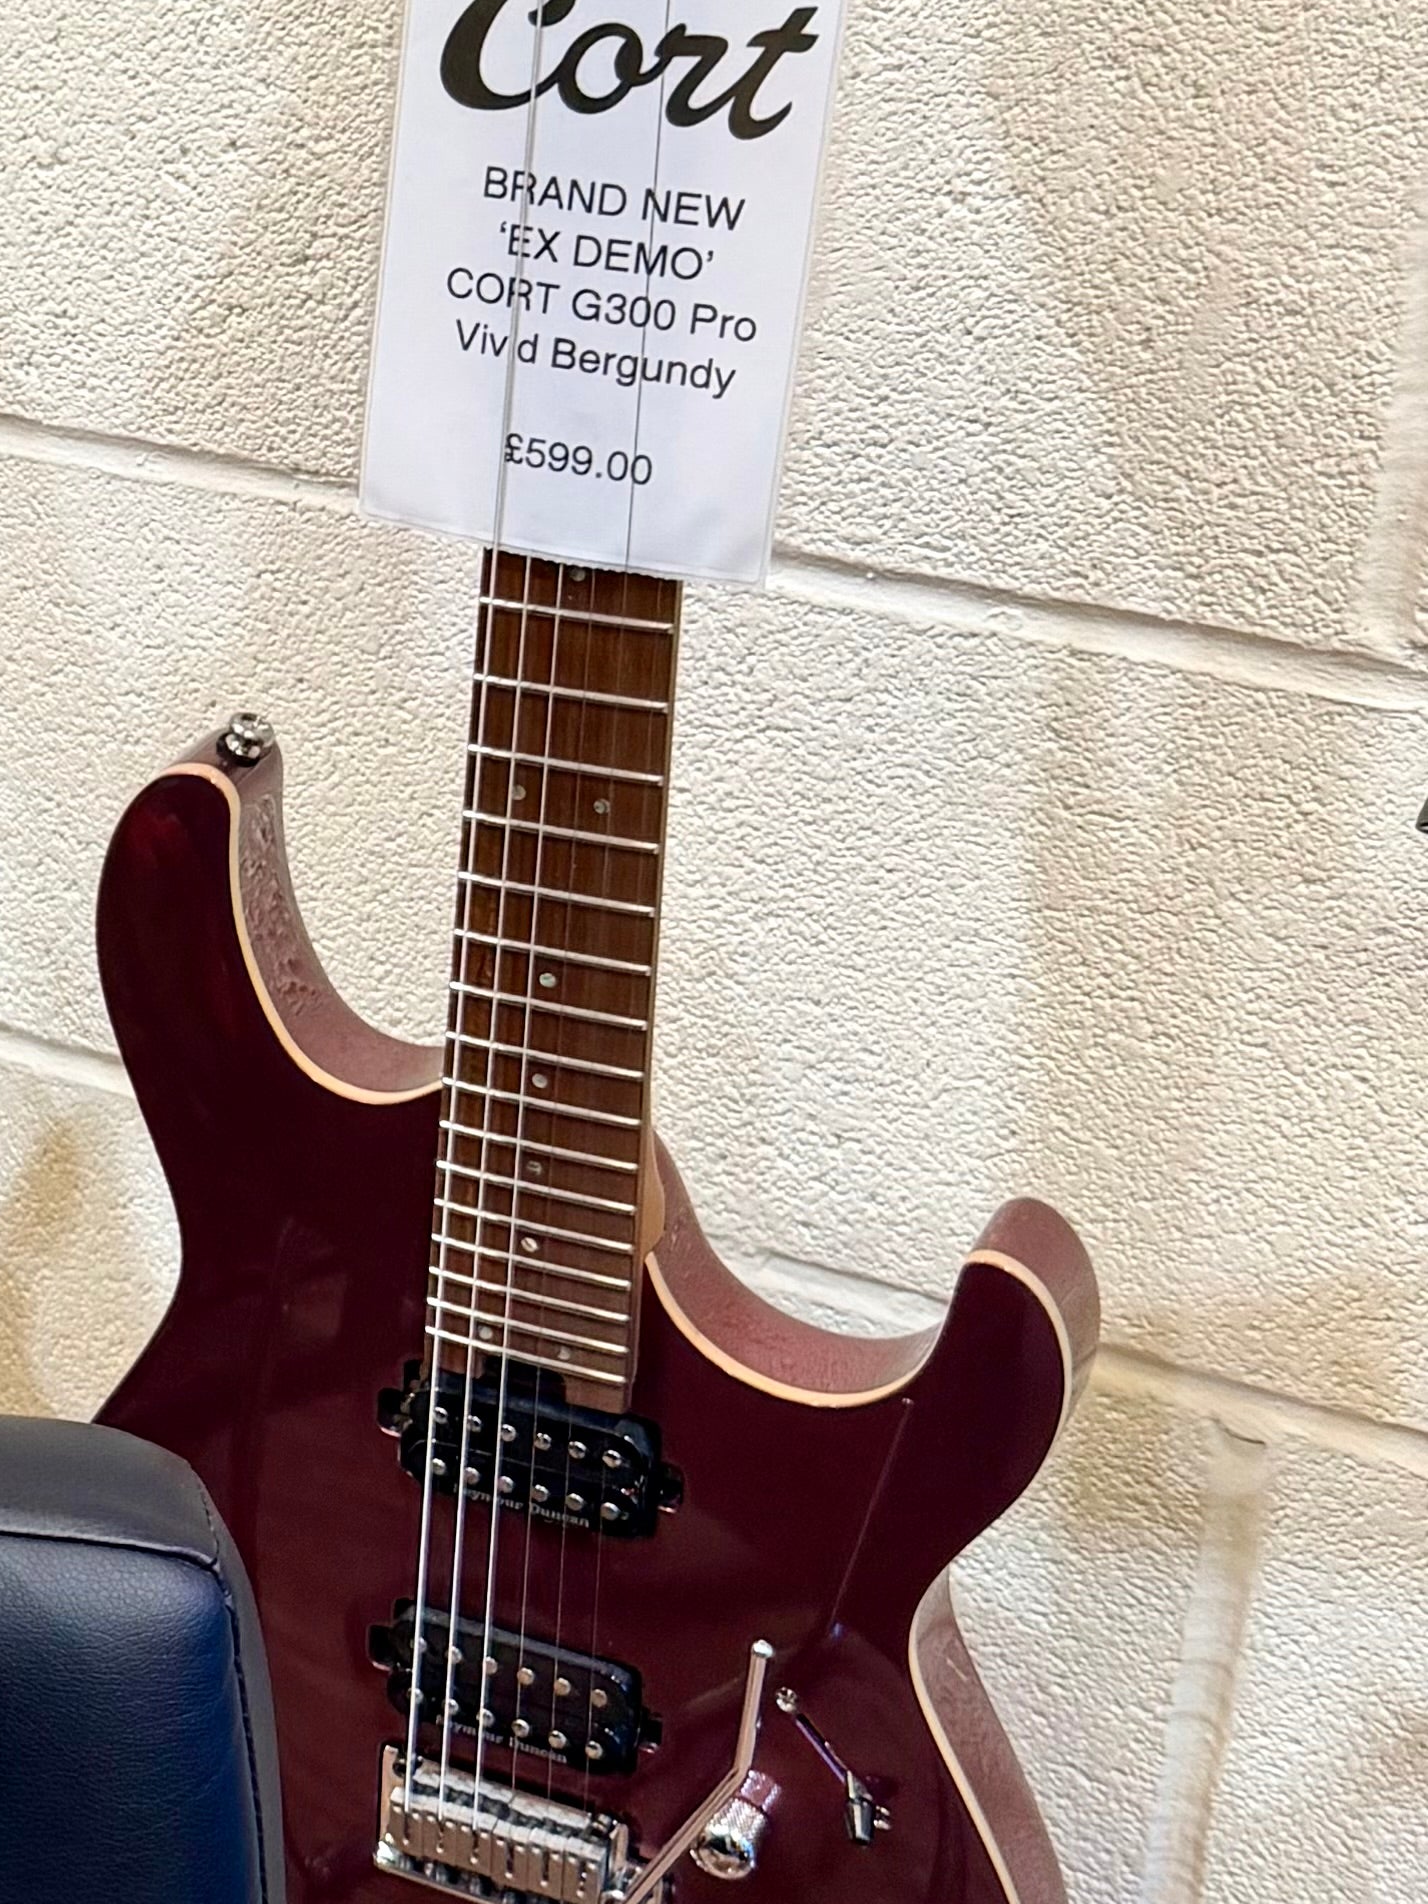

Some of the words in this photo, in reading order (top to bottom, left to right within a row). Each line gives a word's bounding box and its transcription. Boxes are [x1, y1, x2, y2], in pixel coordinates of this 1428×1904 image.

[483, 166, 627, 217] BRAND
[642, 187, 746, 233] NEW
[446, 267, 561, 316] CORT
[571, 287, 676, 332] G300
[689, 303, 758, 344] Pro
[455, 318, 539, 365] Vivd
[551, 337, 736, 399] Bergundy
[504, 432, 654, 487] £599.00
